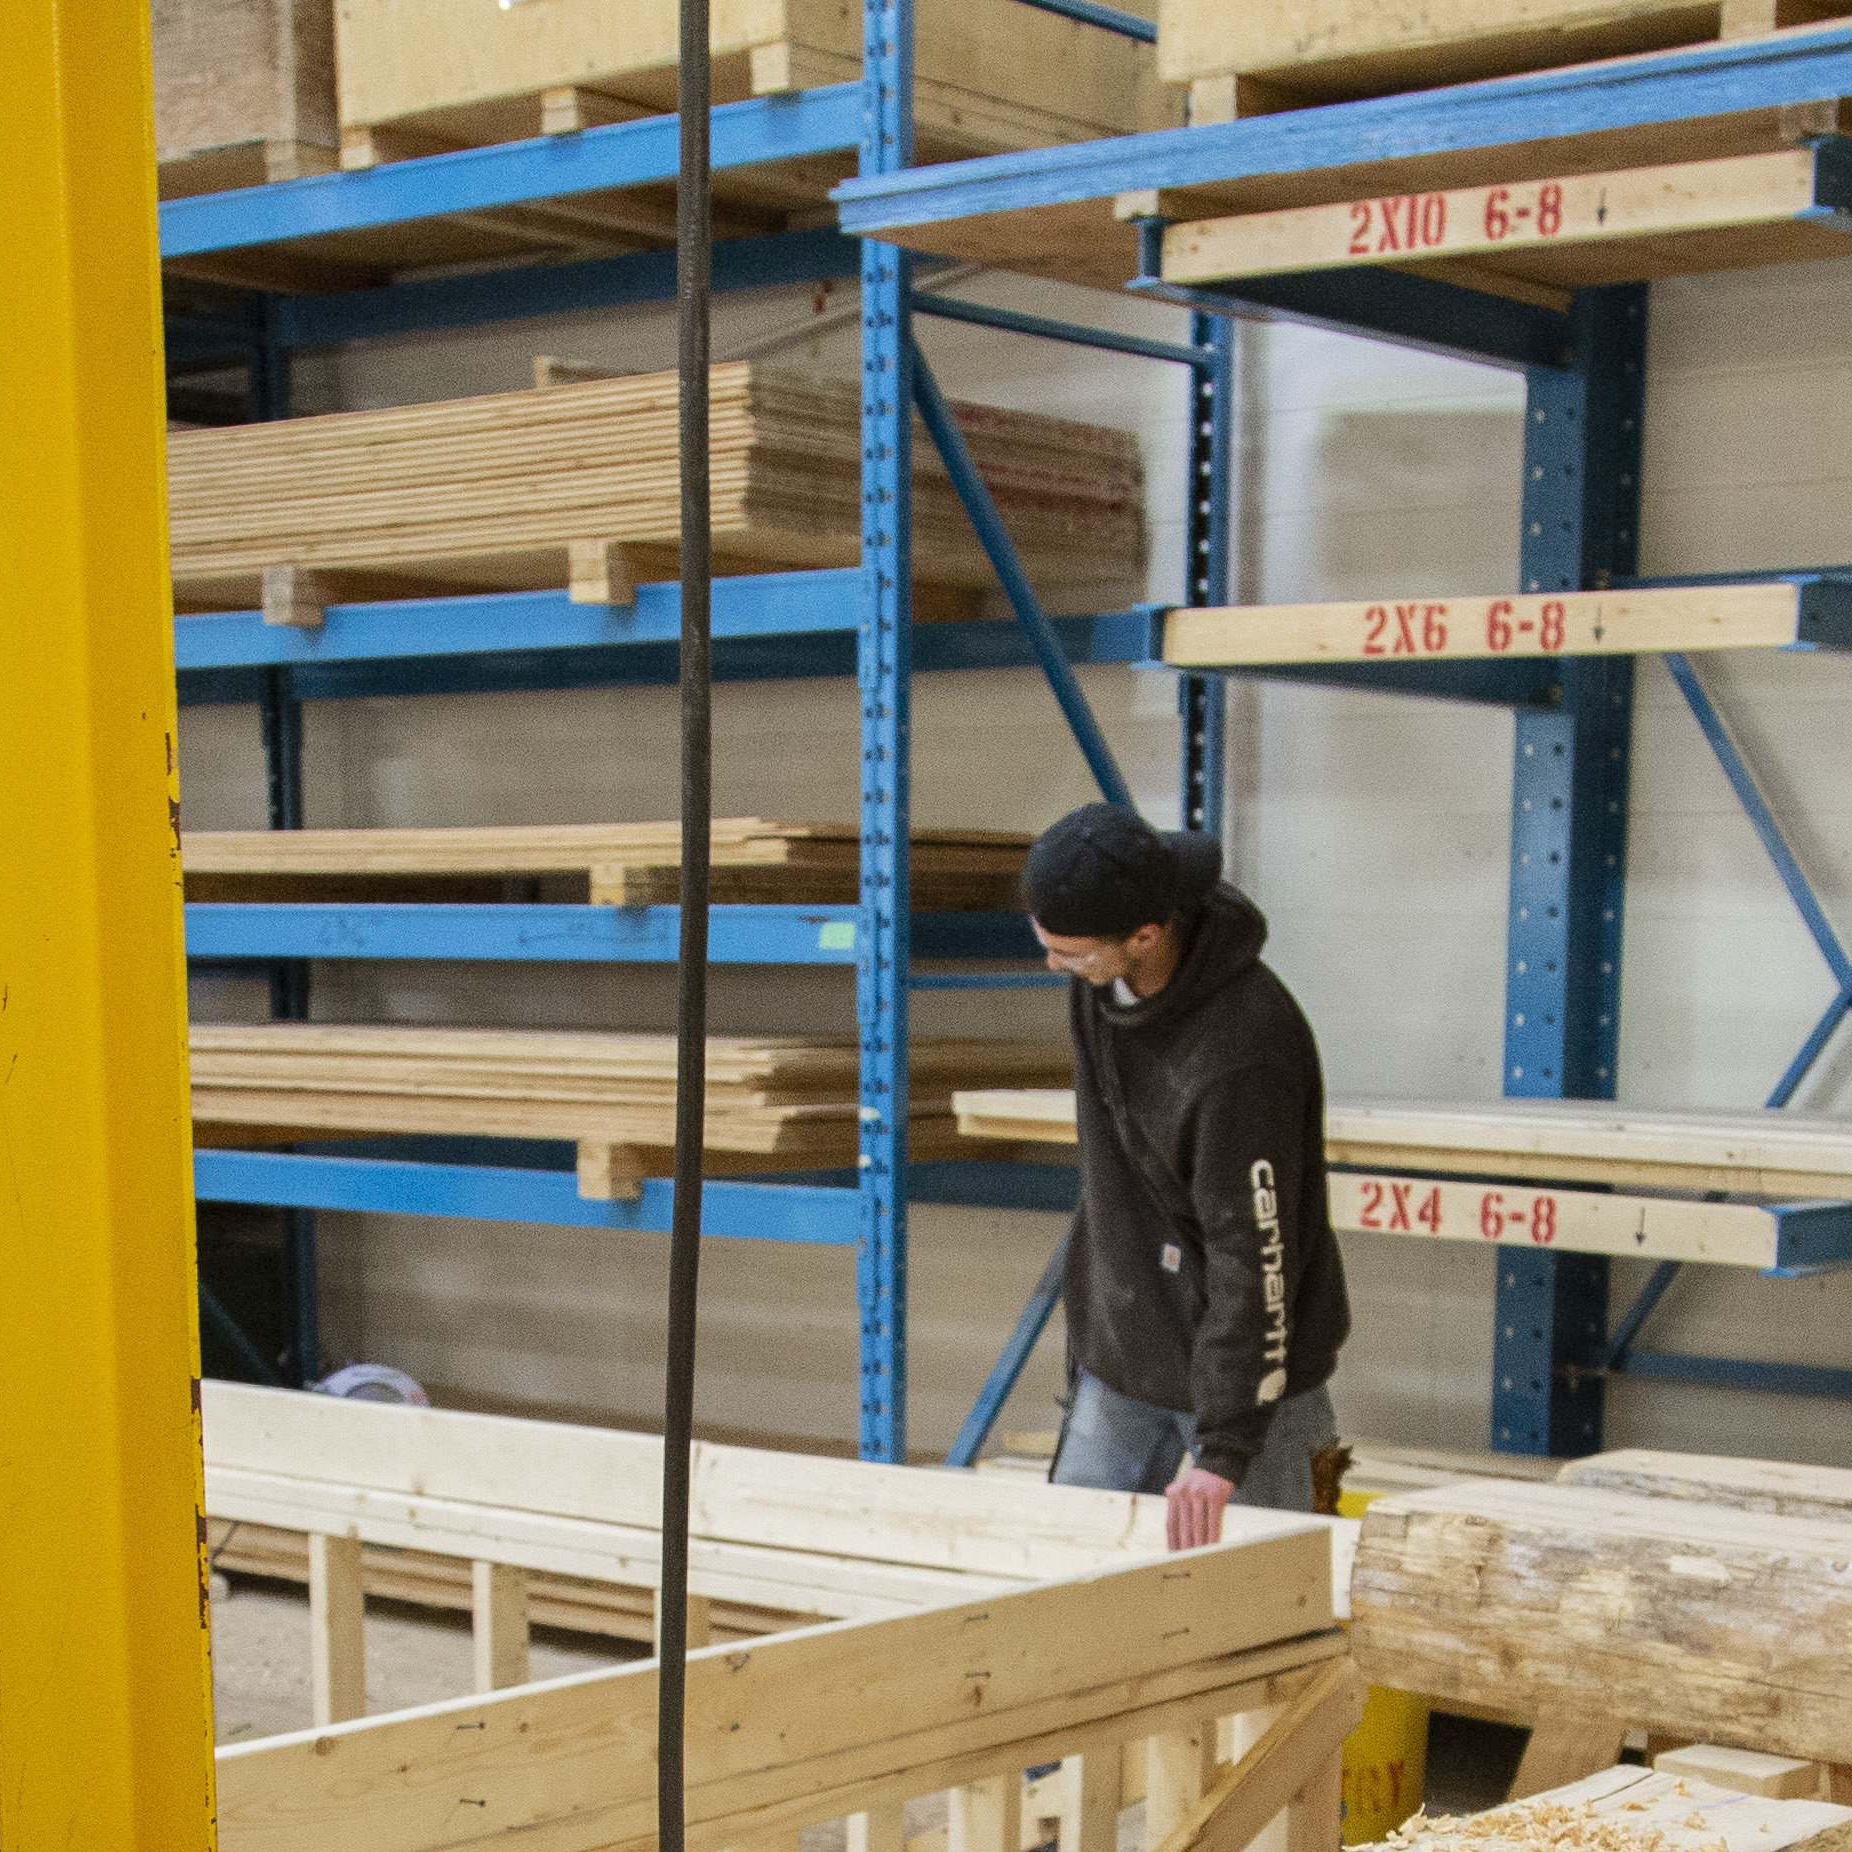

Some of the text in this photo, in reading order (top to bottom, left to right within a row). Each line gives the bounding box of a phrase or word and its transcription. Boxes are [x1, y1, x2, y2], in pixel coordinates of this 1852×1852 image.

[1349, 184, 1563, 254] 2X10 6-8
[1363, 600, 1565, 655] 2X6 6-8
[1359, 1181, 1557, 1245] 2X4 6-8
[1251, 1158, 1287, 1362] carhartt
